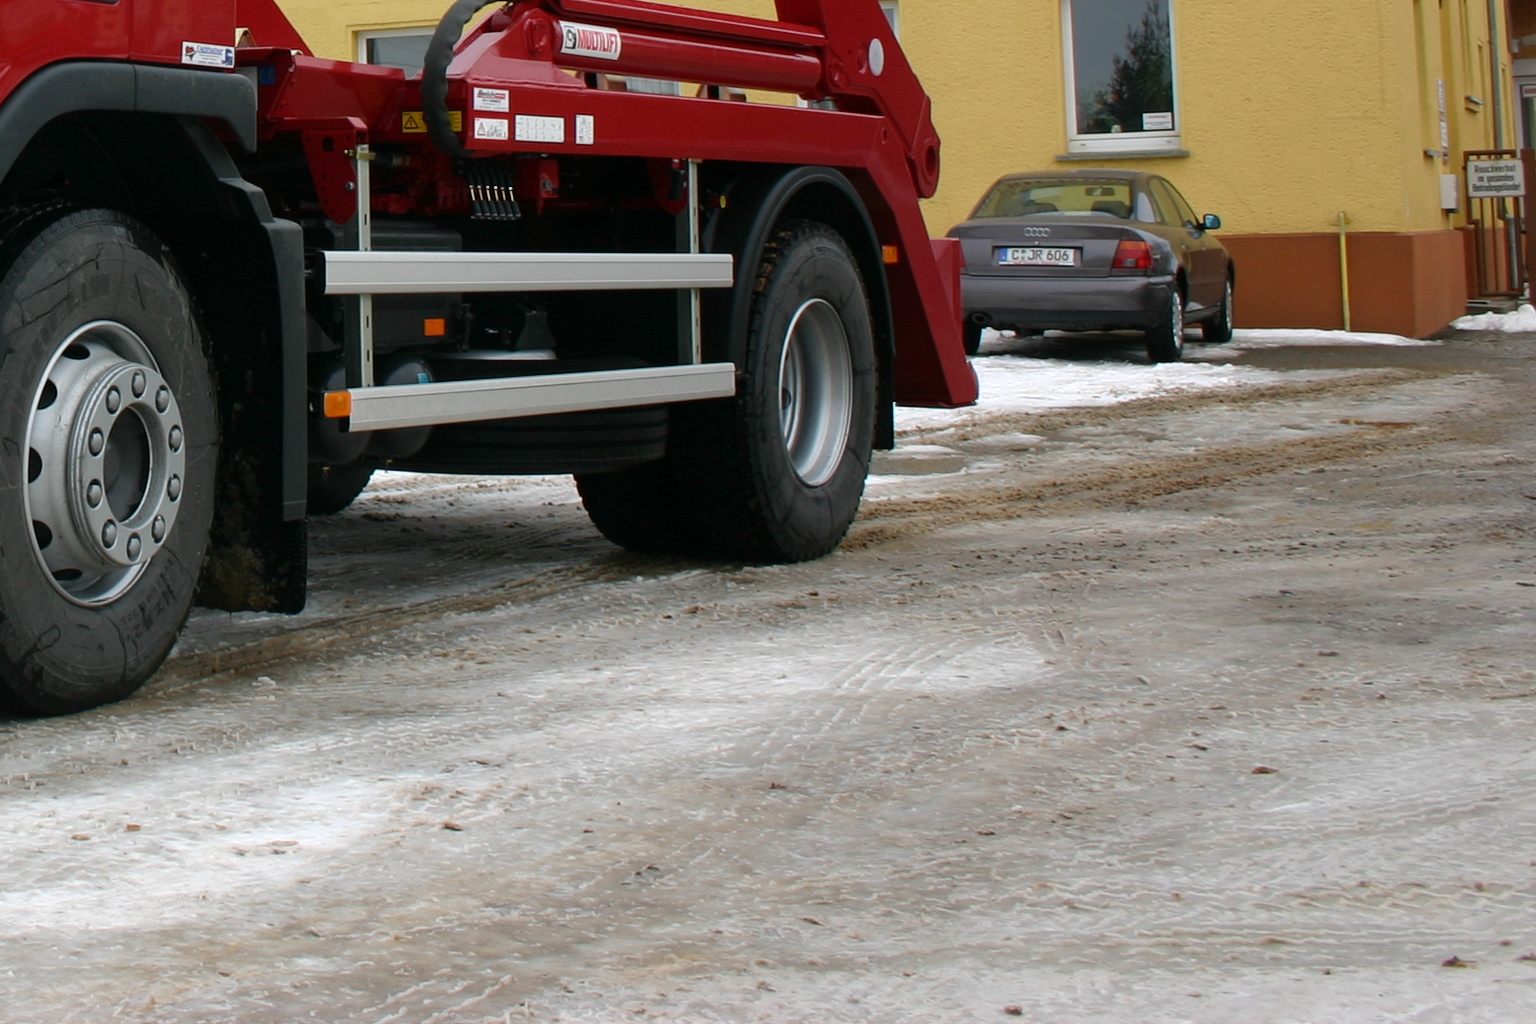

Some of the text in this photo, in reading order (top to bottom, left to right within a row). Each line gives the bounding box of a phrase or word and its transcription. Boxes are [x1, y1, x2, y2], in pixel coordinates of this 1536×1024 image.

[577, 28, 617, 54] MULTILIFT
[1011, 249, 1069, 261] C JR 606
